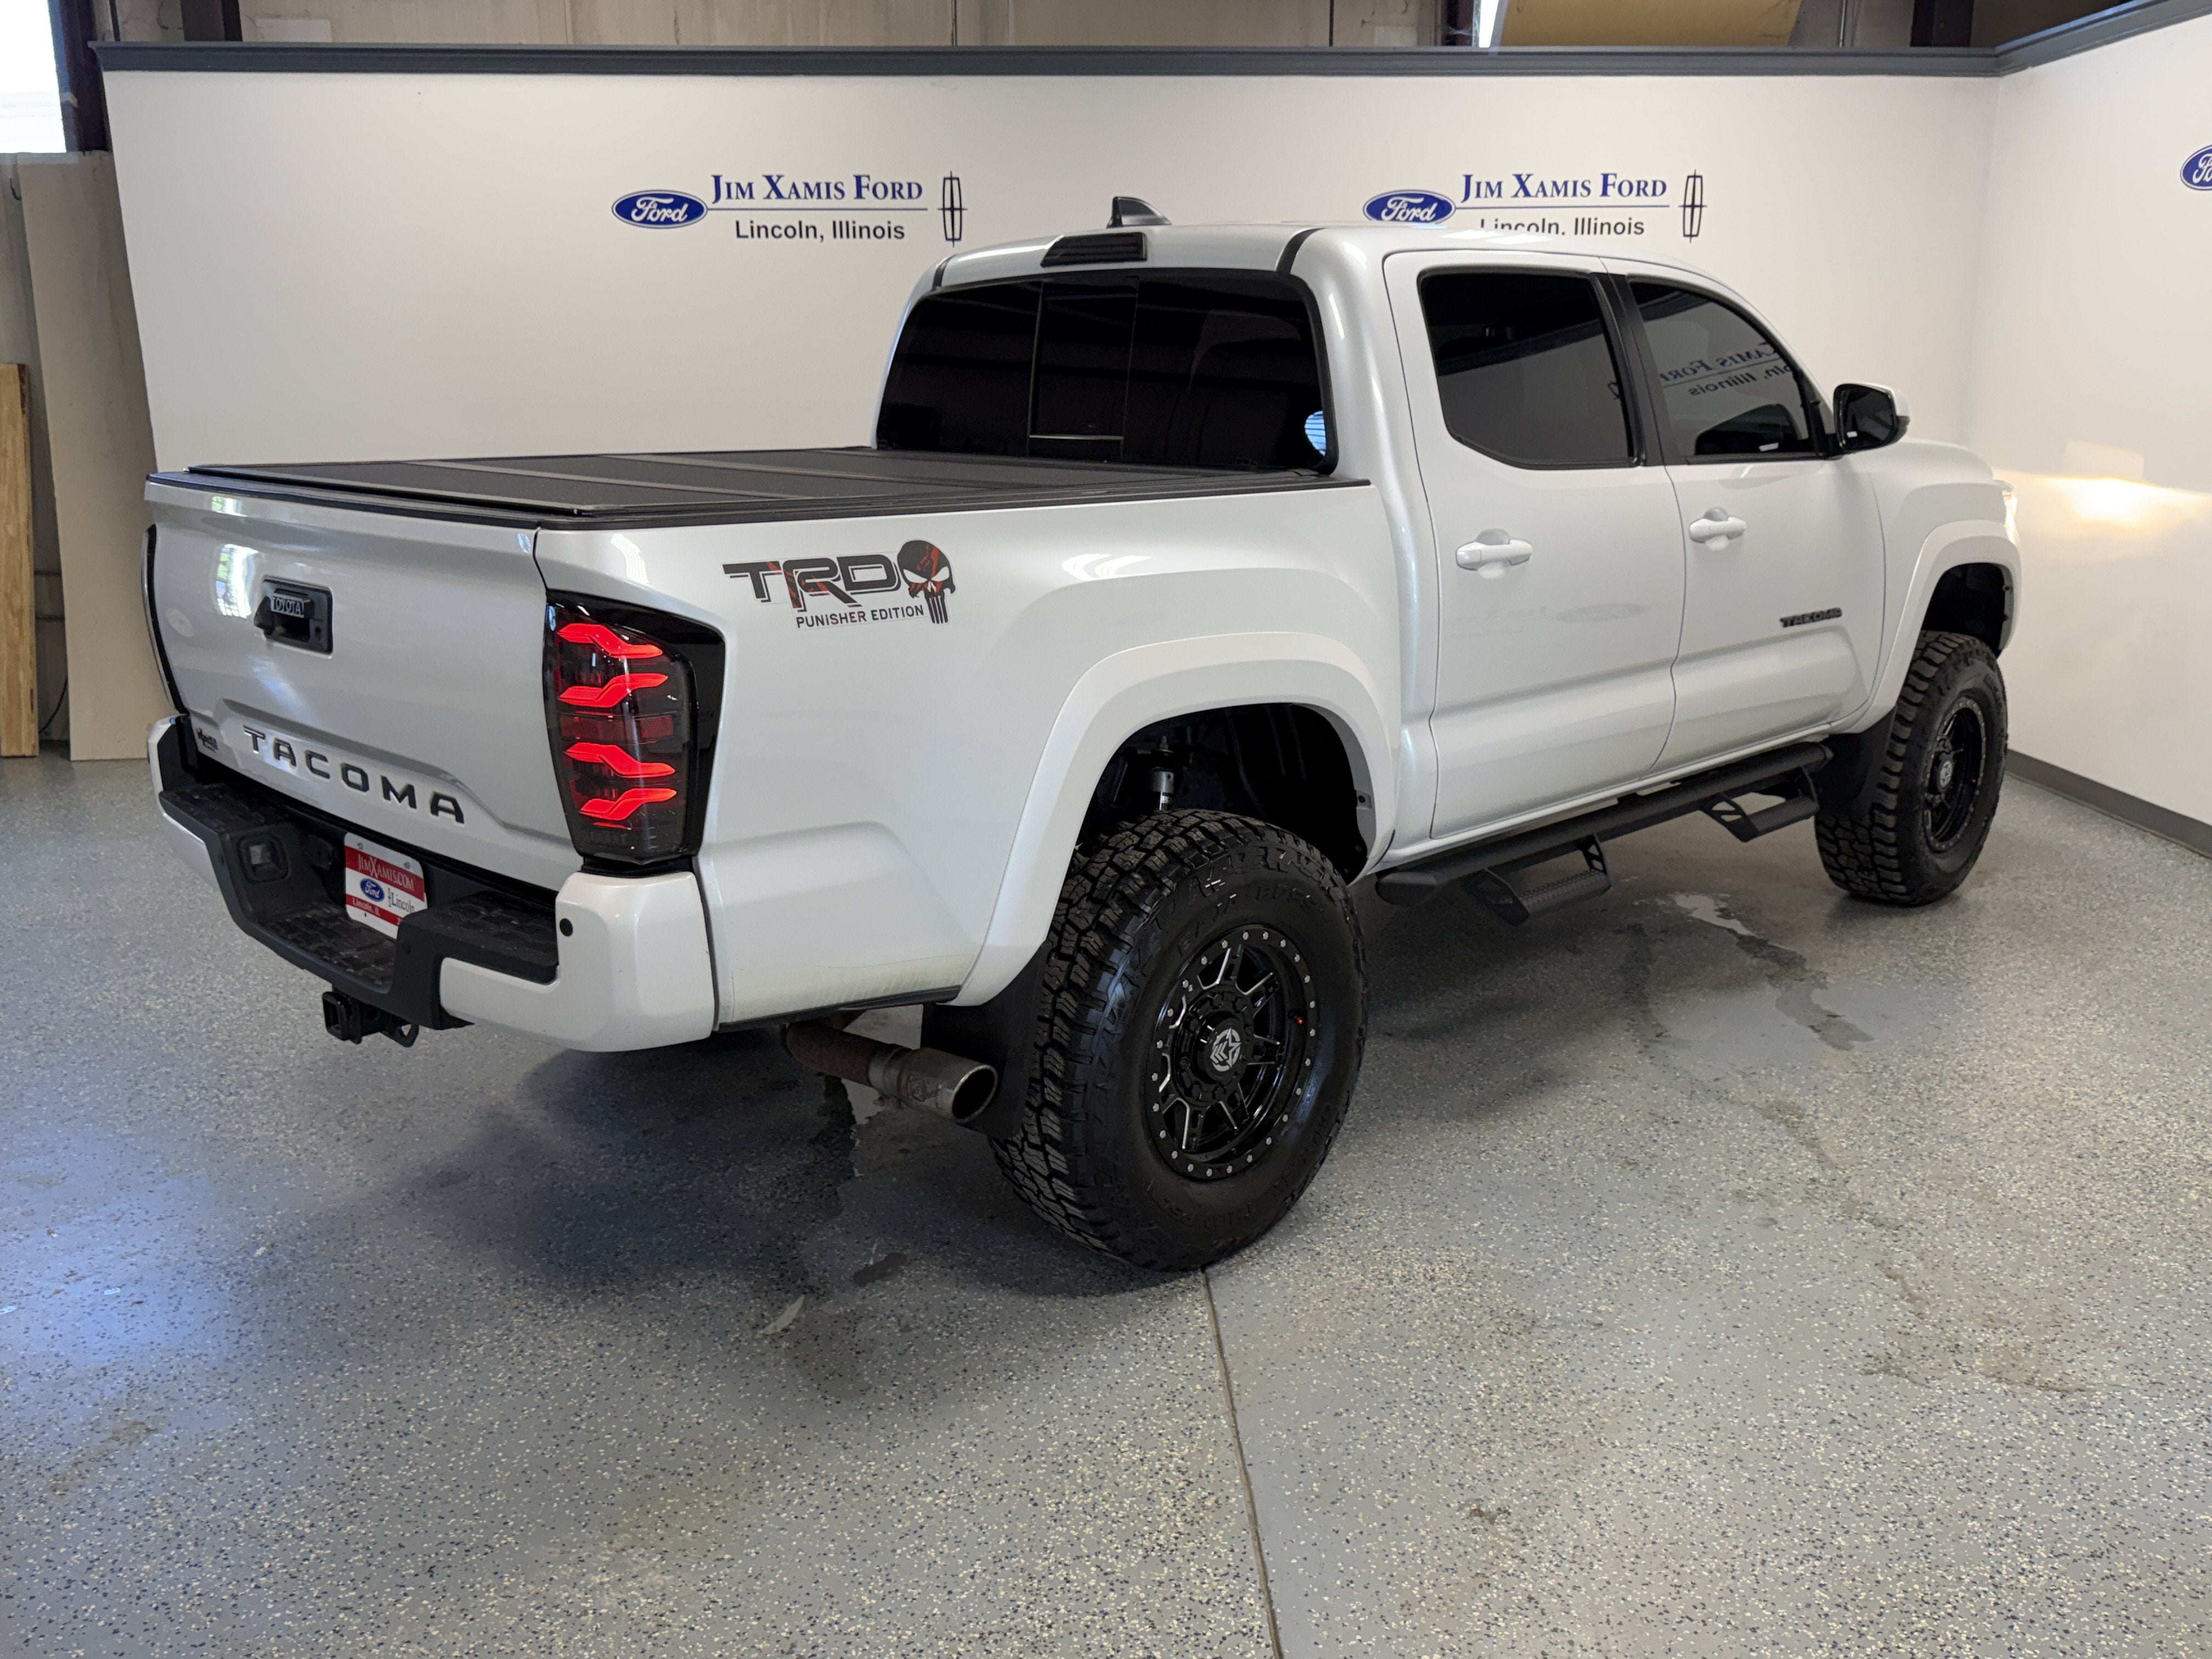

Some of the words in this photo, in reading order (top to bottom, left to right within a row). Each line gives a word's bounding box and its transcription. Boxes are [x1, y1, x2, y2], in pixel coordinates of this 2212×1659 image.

[712, 174, 754, 204] JIM
[762, 174, 845, 200] XAMIS
[853, 174, 923, 200] FORD
[1460, 173, 1503, 203] JIM
[1510, 173, 1592, 198] XAMIS
[1600, 172, 1667, 198] FORD
[630, 196, 688, 223] Ford
[1380, 196, 1437, 222] Ford
[735, 220, 824, 242] Lincoln,
[832, 220, 905, 240] Illinois
[1575, 217, 1645, 235] Illinois
[722, 554, 901, 612] TRD
[273, 595, 304, 615] TOYOTA
[796, 611, 867, 629] PUNISHER
[871, 605, 924, 621] EDITION
[243, 725, 465, 825] TACOMA
[364, 881, 380, 899] Ford
